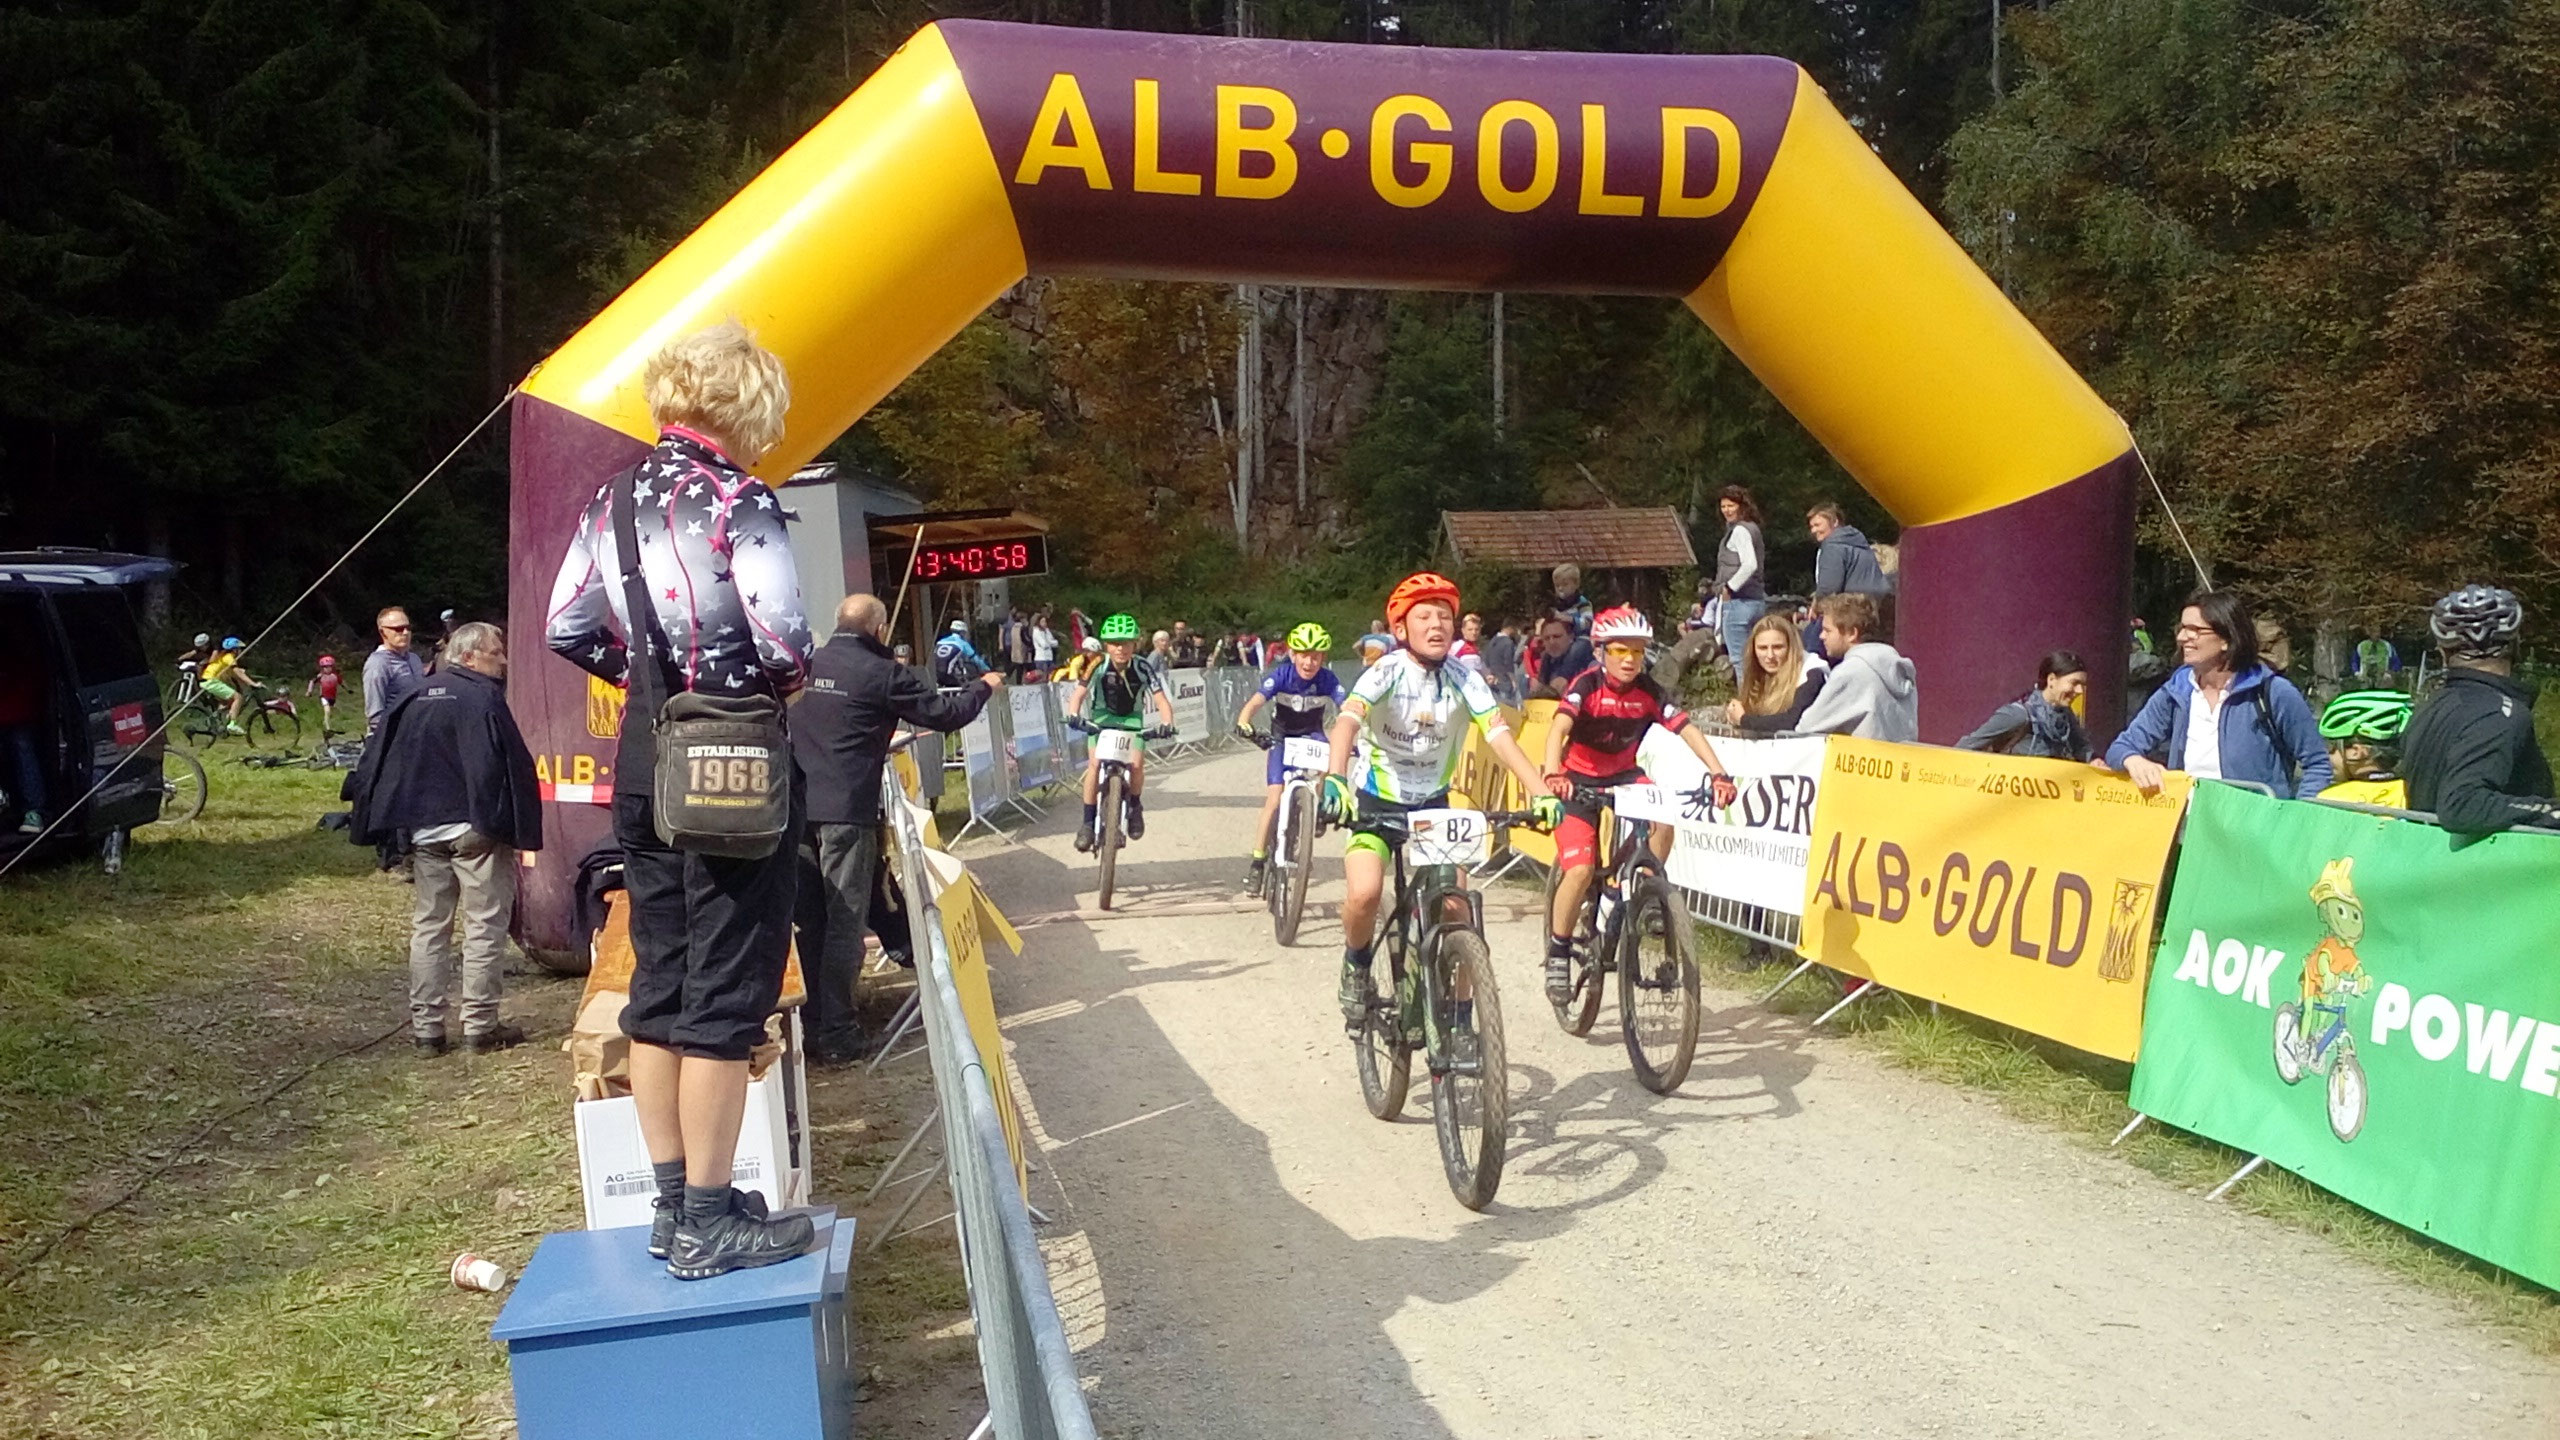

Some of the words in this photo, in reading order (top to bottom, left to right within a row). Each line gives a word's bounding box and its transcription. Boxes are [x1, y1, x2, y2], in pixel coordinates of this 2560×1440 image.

[915, 544, 1027, 577] 13:40:58
[687, 745, 769, 759] ESTABLISHED
[1115, 736, 1131, 751] 104
[1306, 744, 1322, 759] 90
[688, 758, 770, 793] 1968
[686, 796, 703, 805] San
[704, 796, 746, 807] Francisco
[1646, 788, 1663, 806] 91
[1446, 817, 1473, 843] 82
[1767, 842, 1809, 868] LIMITED
[1812, 831, 2093, 969] ALB·GOLD
[2173, 928, 2286, 1010] AOK
[2370, 981, 2560, 1100] POWE
[605, 1173, 625, 1184] AG
